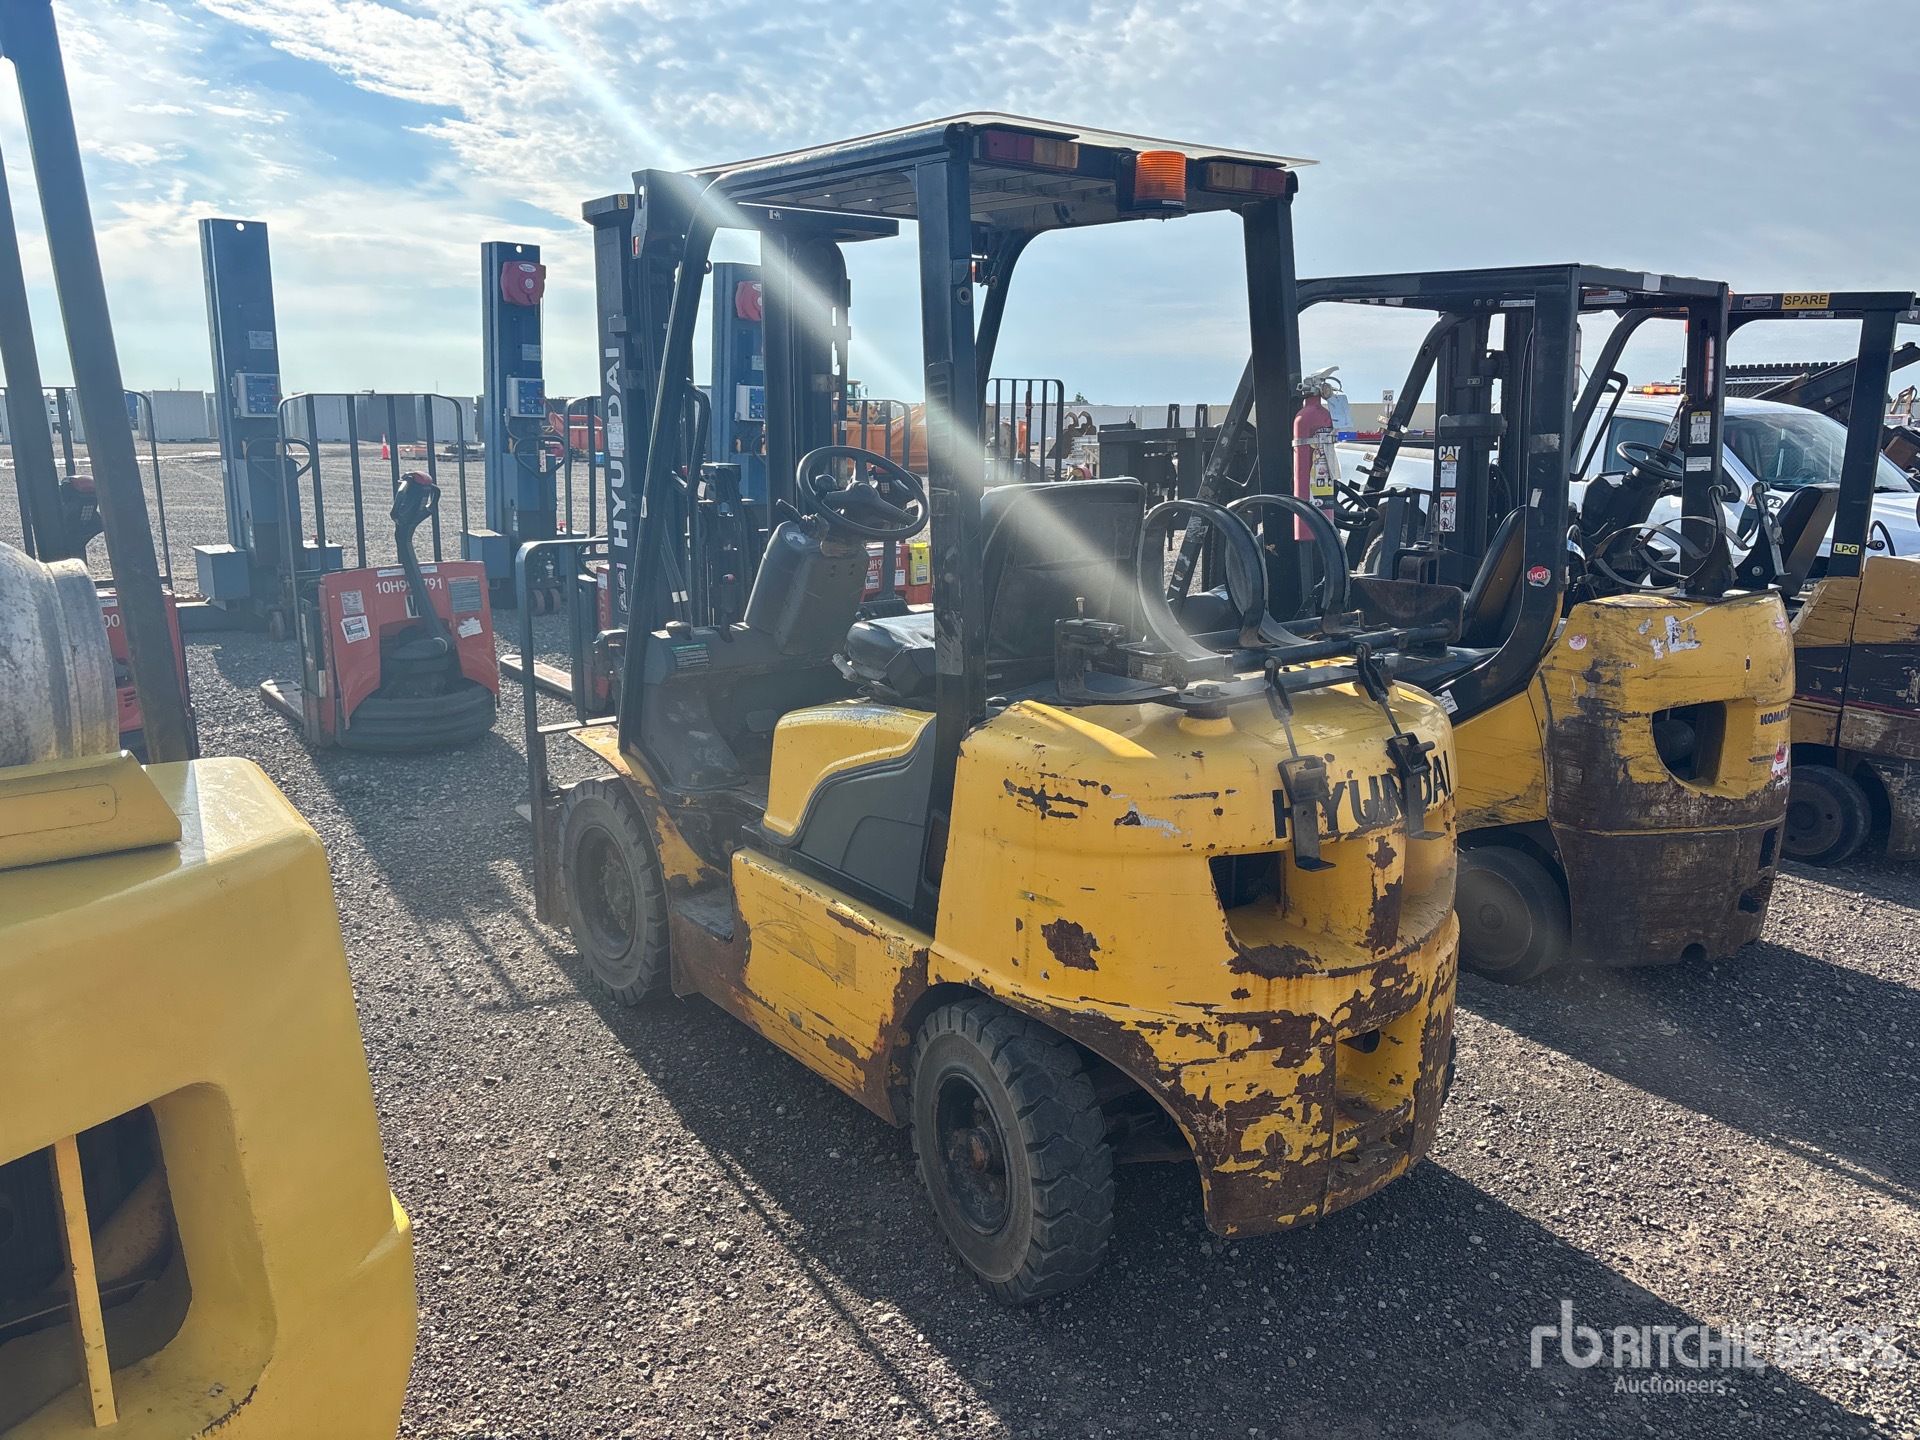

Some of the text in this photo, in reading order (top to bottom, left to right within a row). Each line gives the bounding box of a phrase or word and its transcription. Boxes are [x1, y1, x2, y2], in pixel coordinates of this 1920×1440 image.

[1783, 294, 1829, 306] SPARE
[1383, 394, 1394, 402] 40
[605, 347, 628, 548] HYUDAI
[1438, 445, 1461, 461] CAT
[1766, 498, 1782, 509] 93
[1834, 544, 1859, 555] LPG
[1530, 571, 1547, 581] HOT
